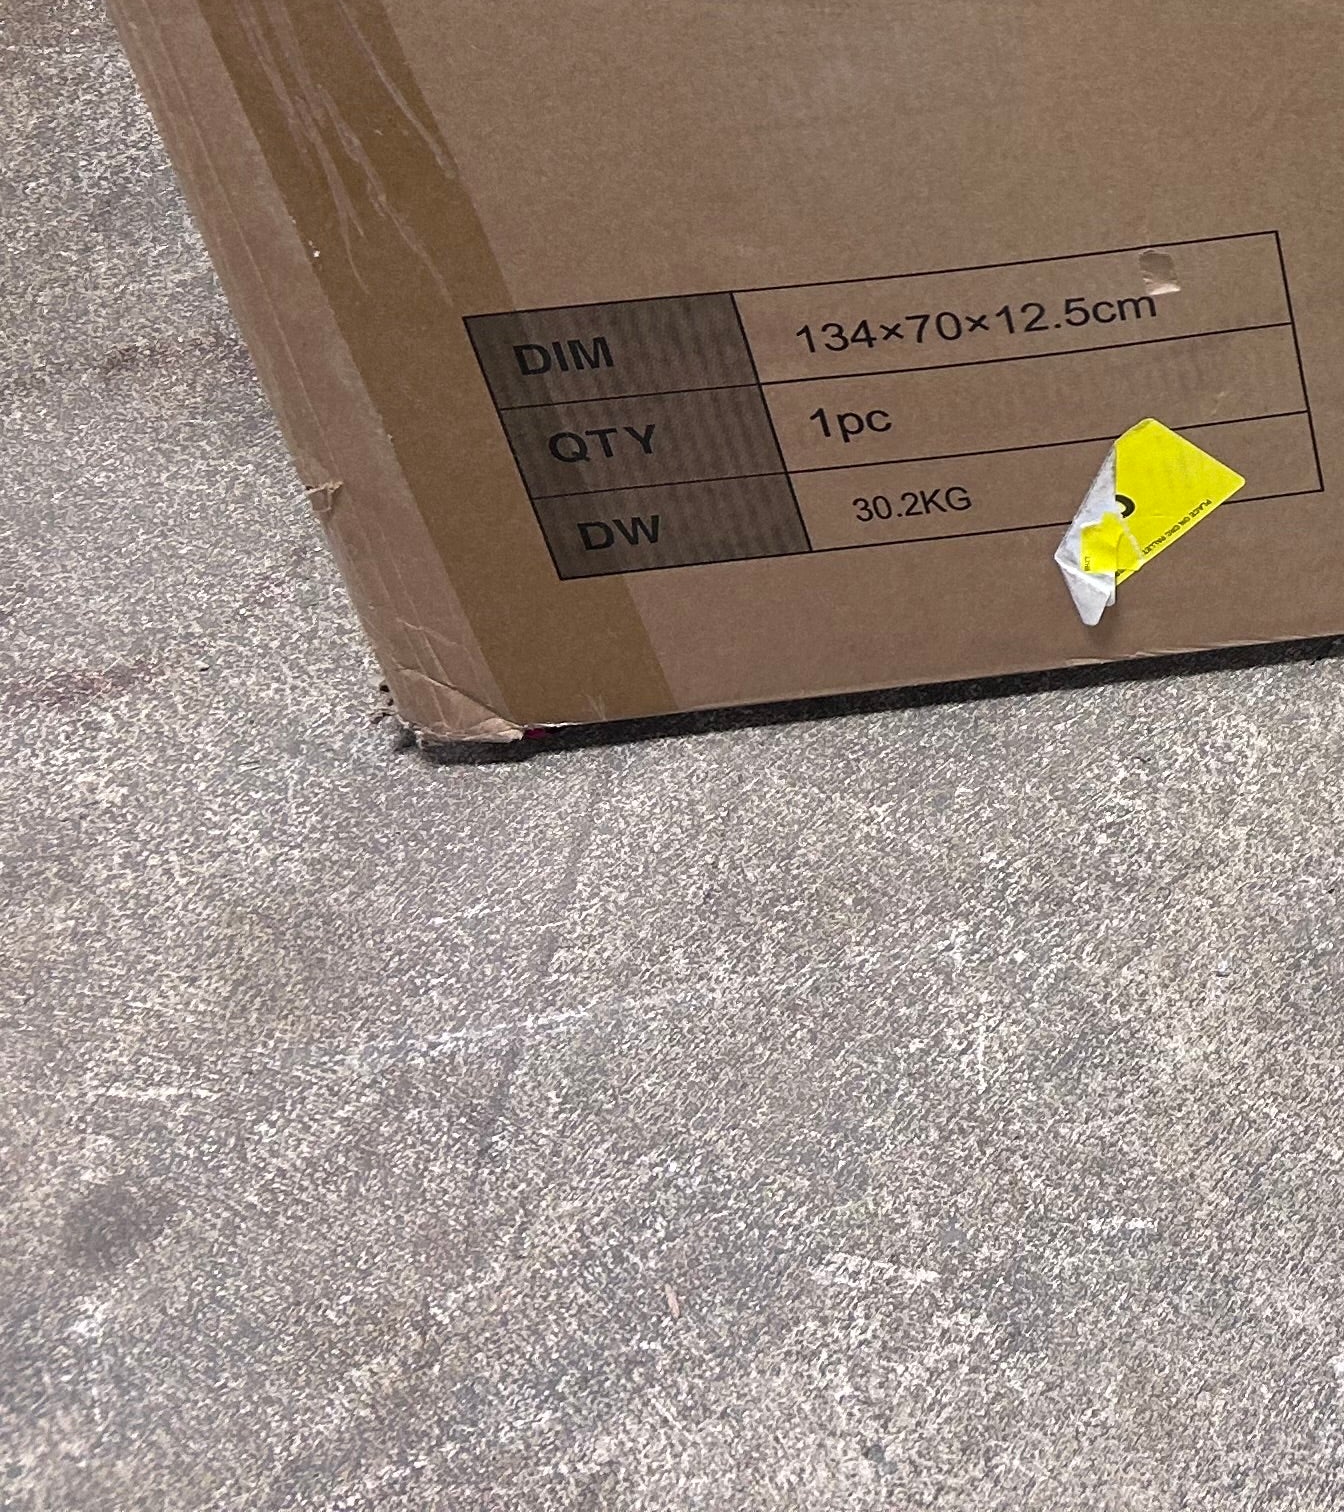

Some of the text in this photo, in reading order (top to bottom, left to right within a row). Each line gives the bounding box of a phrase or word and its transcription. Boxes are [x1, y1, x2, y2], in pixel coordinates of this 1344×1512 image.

[514, 335, 616, 378] DIM
[547, 404, 894, 466] QTY 1pc
[576, 484, 974, 554] DW 30.2KG
